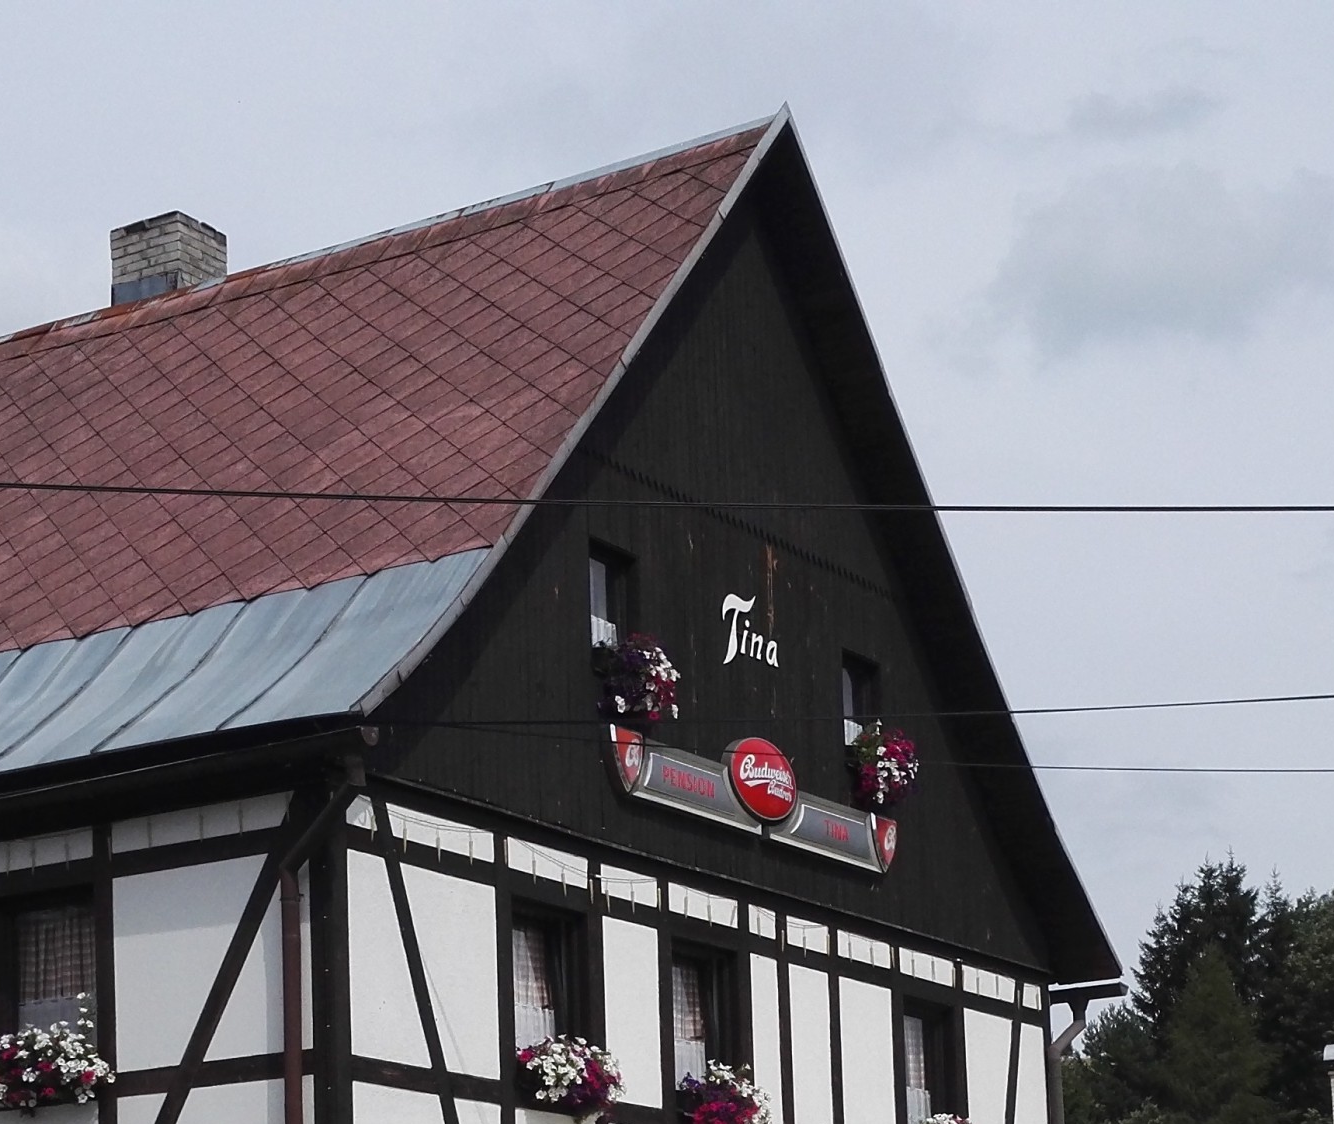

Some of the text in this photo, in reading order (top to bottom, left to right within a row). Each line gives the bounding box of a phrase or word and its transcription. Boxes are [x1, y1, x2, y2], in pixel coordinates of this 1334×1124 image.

[722, 593, 779, 668] Tina
[661, 765, 715, 799] PENSION
[739, 753, 794, 790] Budweiser
[767, 779, 793, 803] Budvar
[824, 818, 849, 843] TINA
